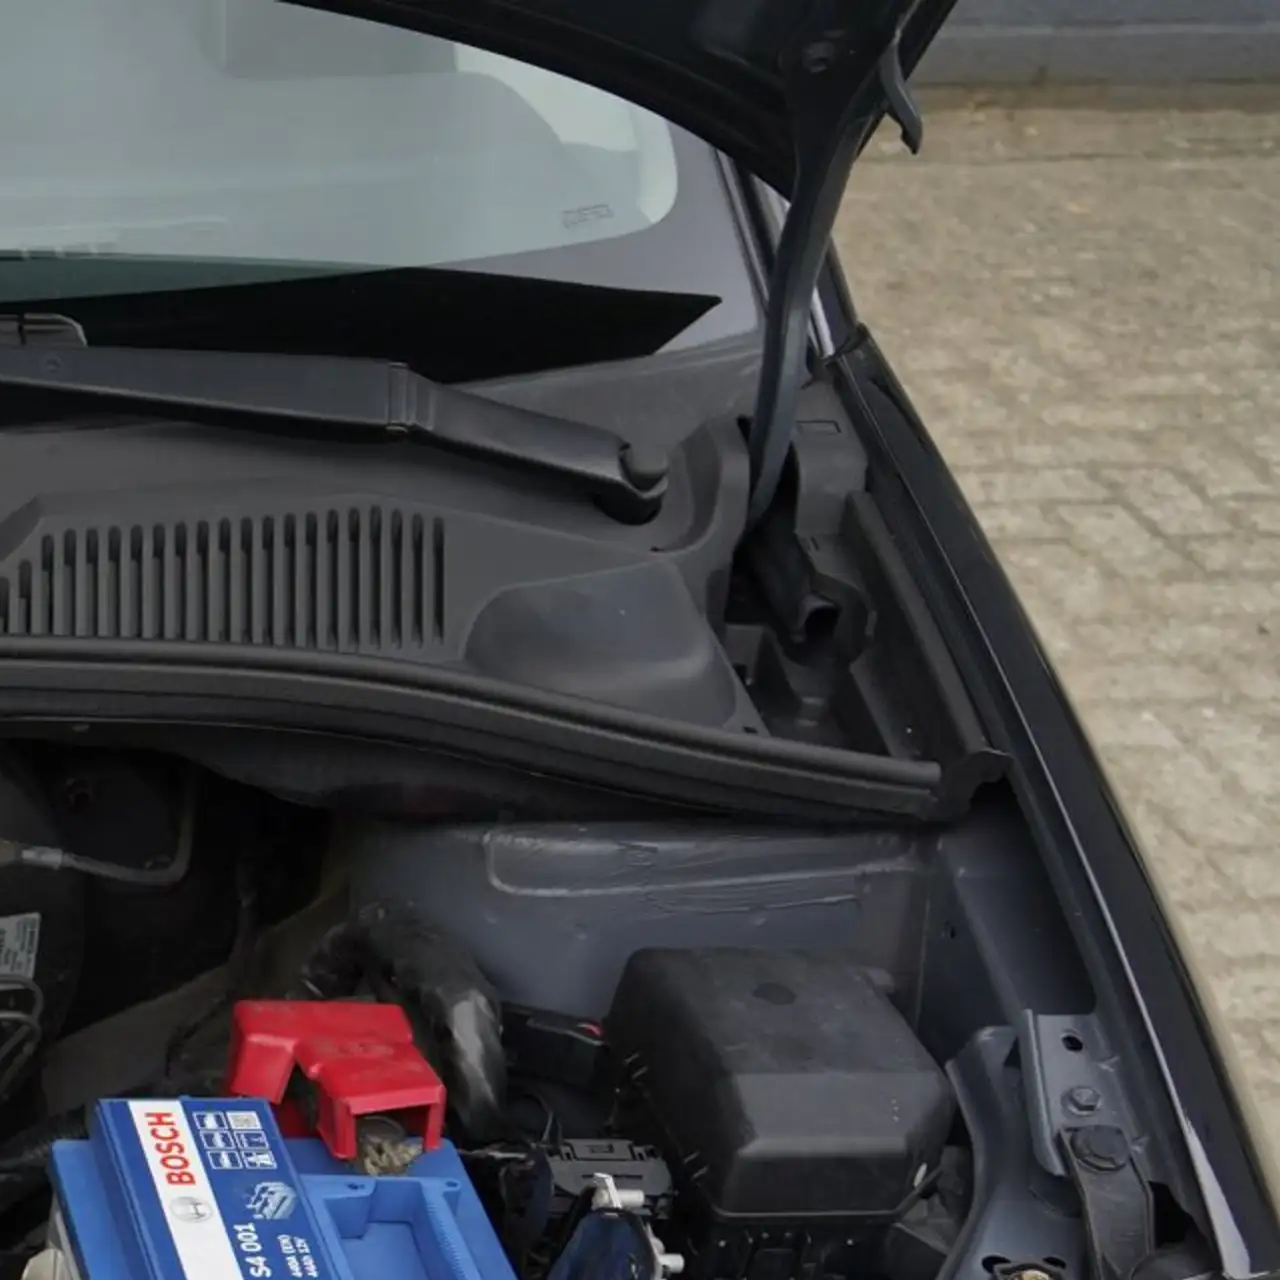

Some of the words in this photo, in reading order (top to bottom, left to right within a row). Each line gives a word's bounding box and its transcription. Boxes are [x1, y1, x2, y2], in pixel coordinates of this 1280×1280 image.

[144, 1112, 196, 1186] BOSCH
[232, 1222, 263, 1253] 001
[244, 1255, 273, 1279] S4
